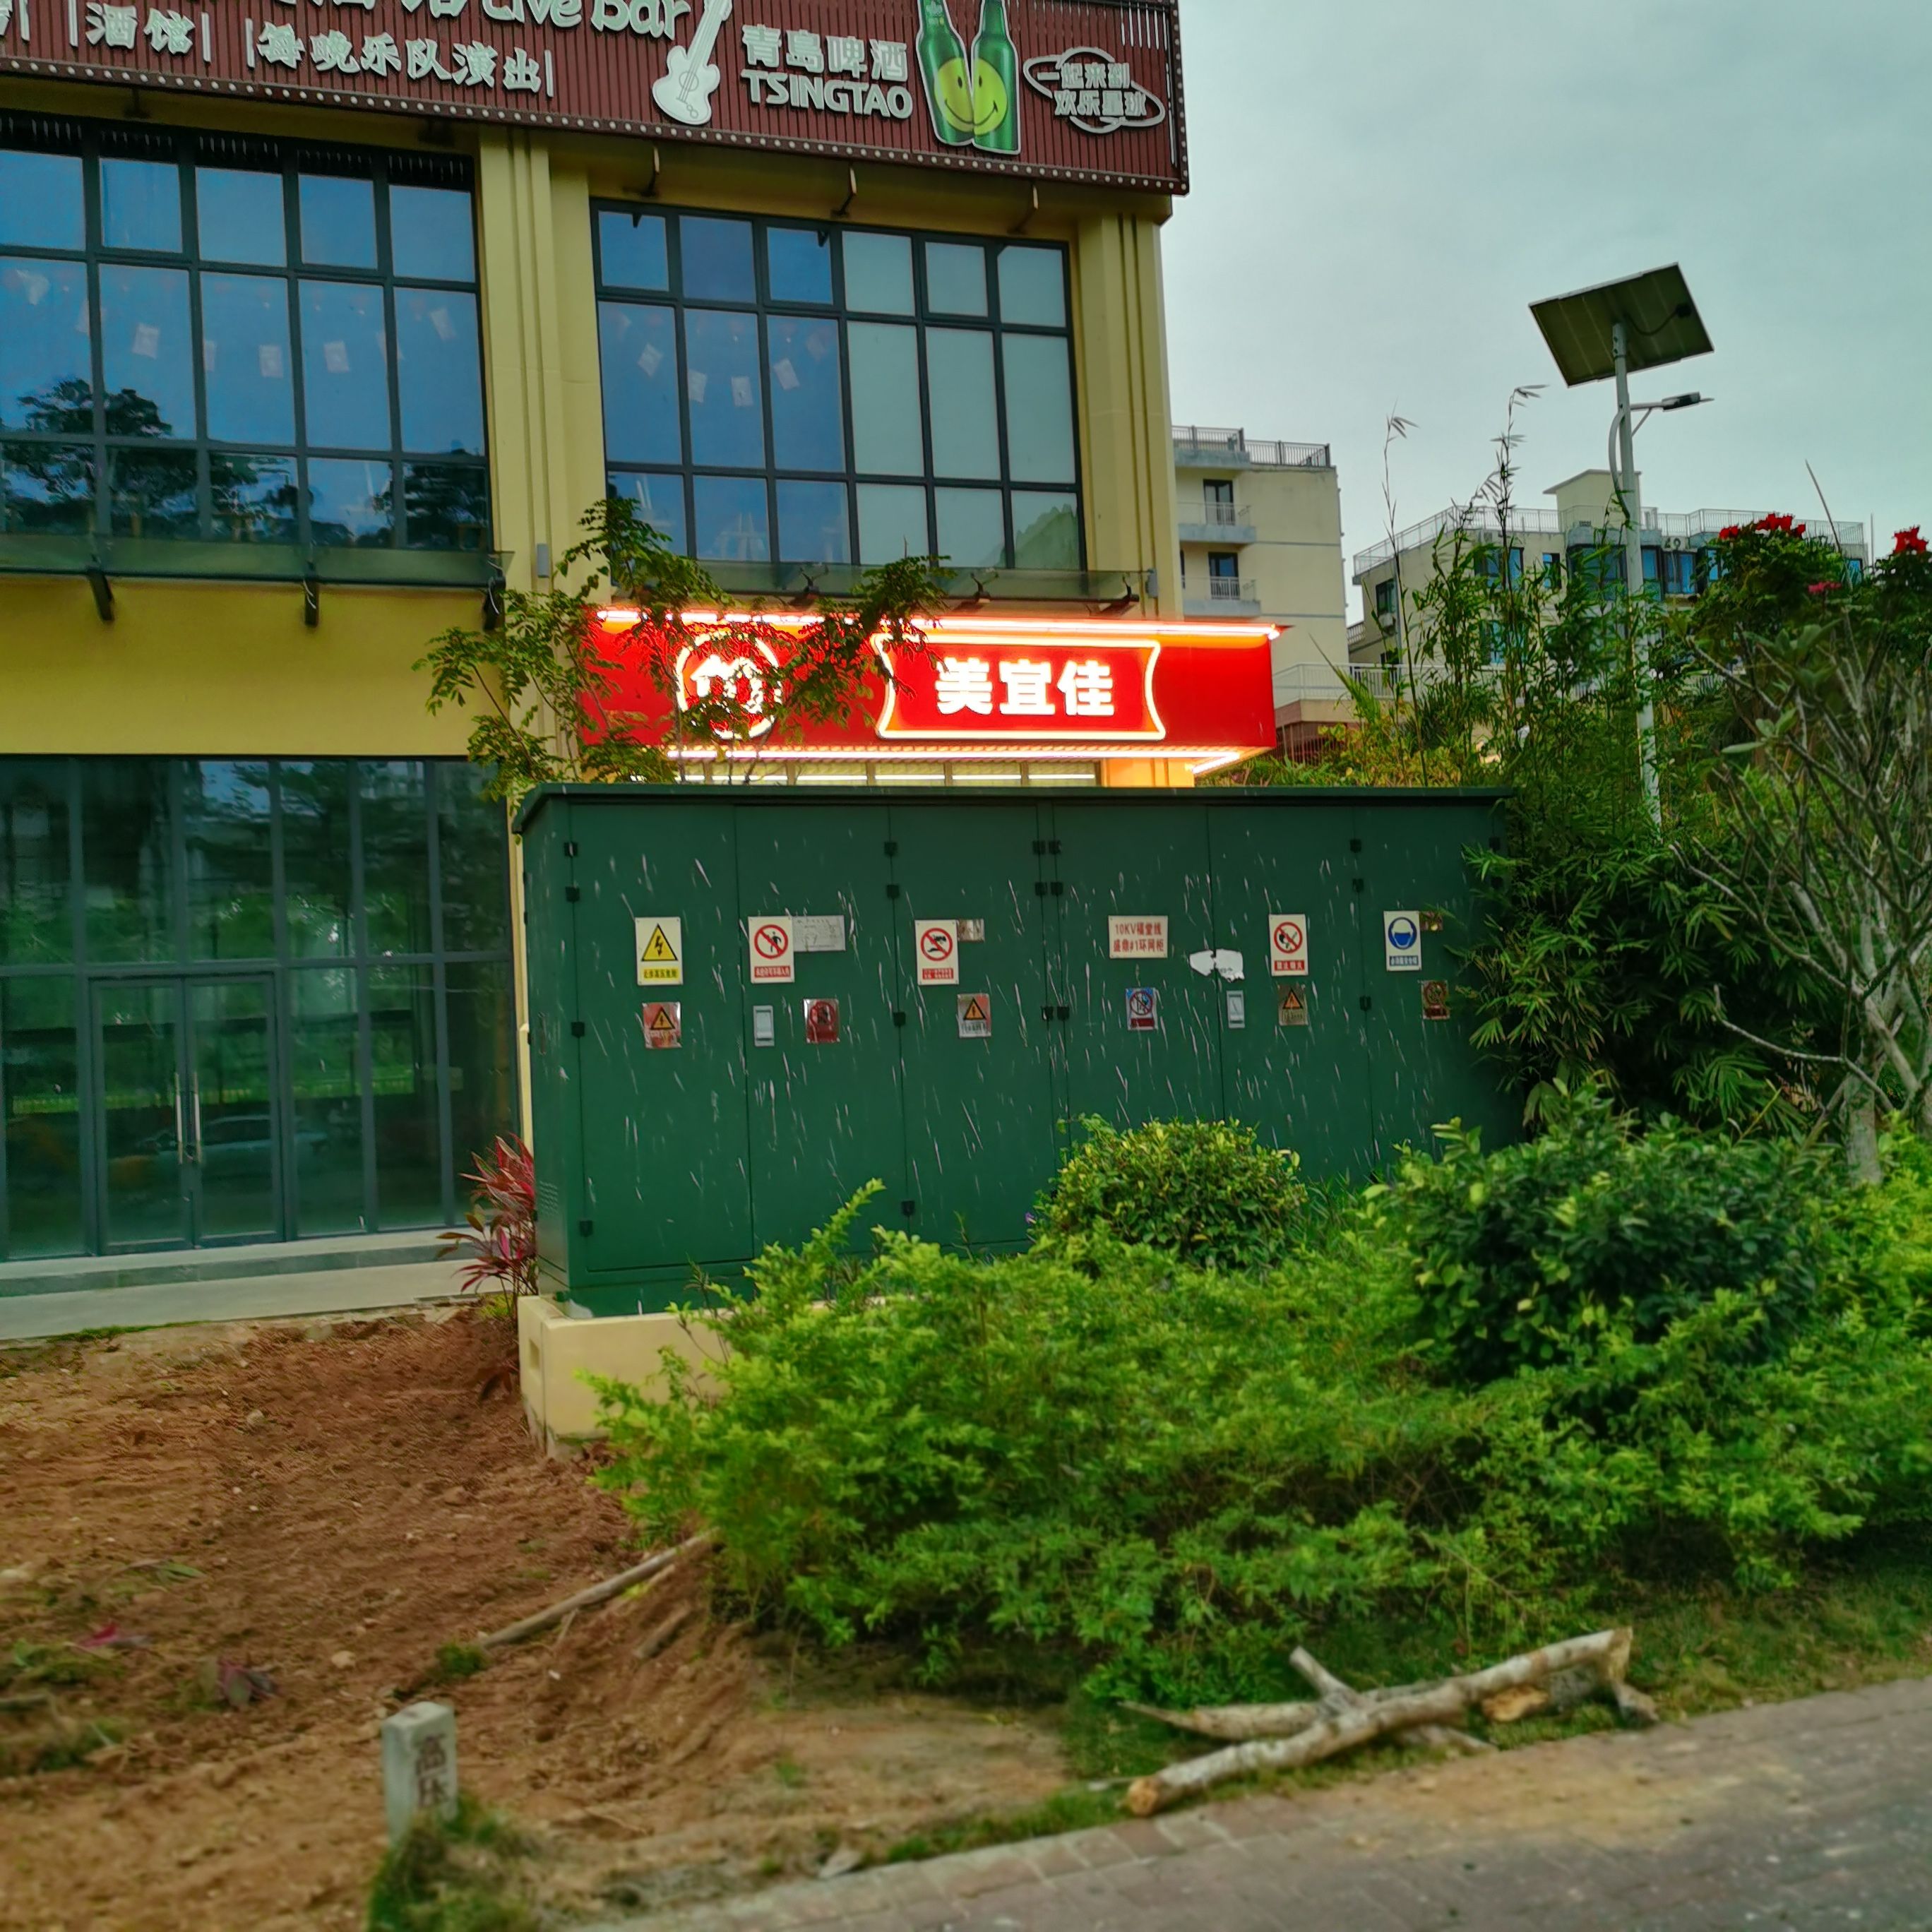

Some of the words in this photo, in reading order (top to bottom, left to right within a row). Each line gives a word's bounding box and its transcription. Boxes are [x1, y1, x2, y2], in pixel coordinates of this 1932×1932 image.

[85, 2, 196, 56] 酒馆
[258, 21, 542, 93] 每晚乐队演出
[741, 68, 913, 119] TSINGTAO
[935, 657, 1115, 716] 美宜佳
